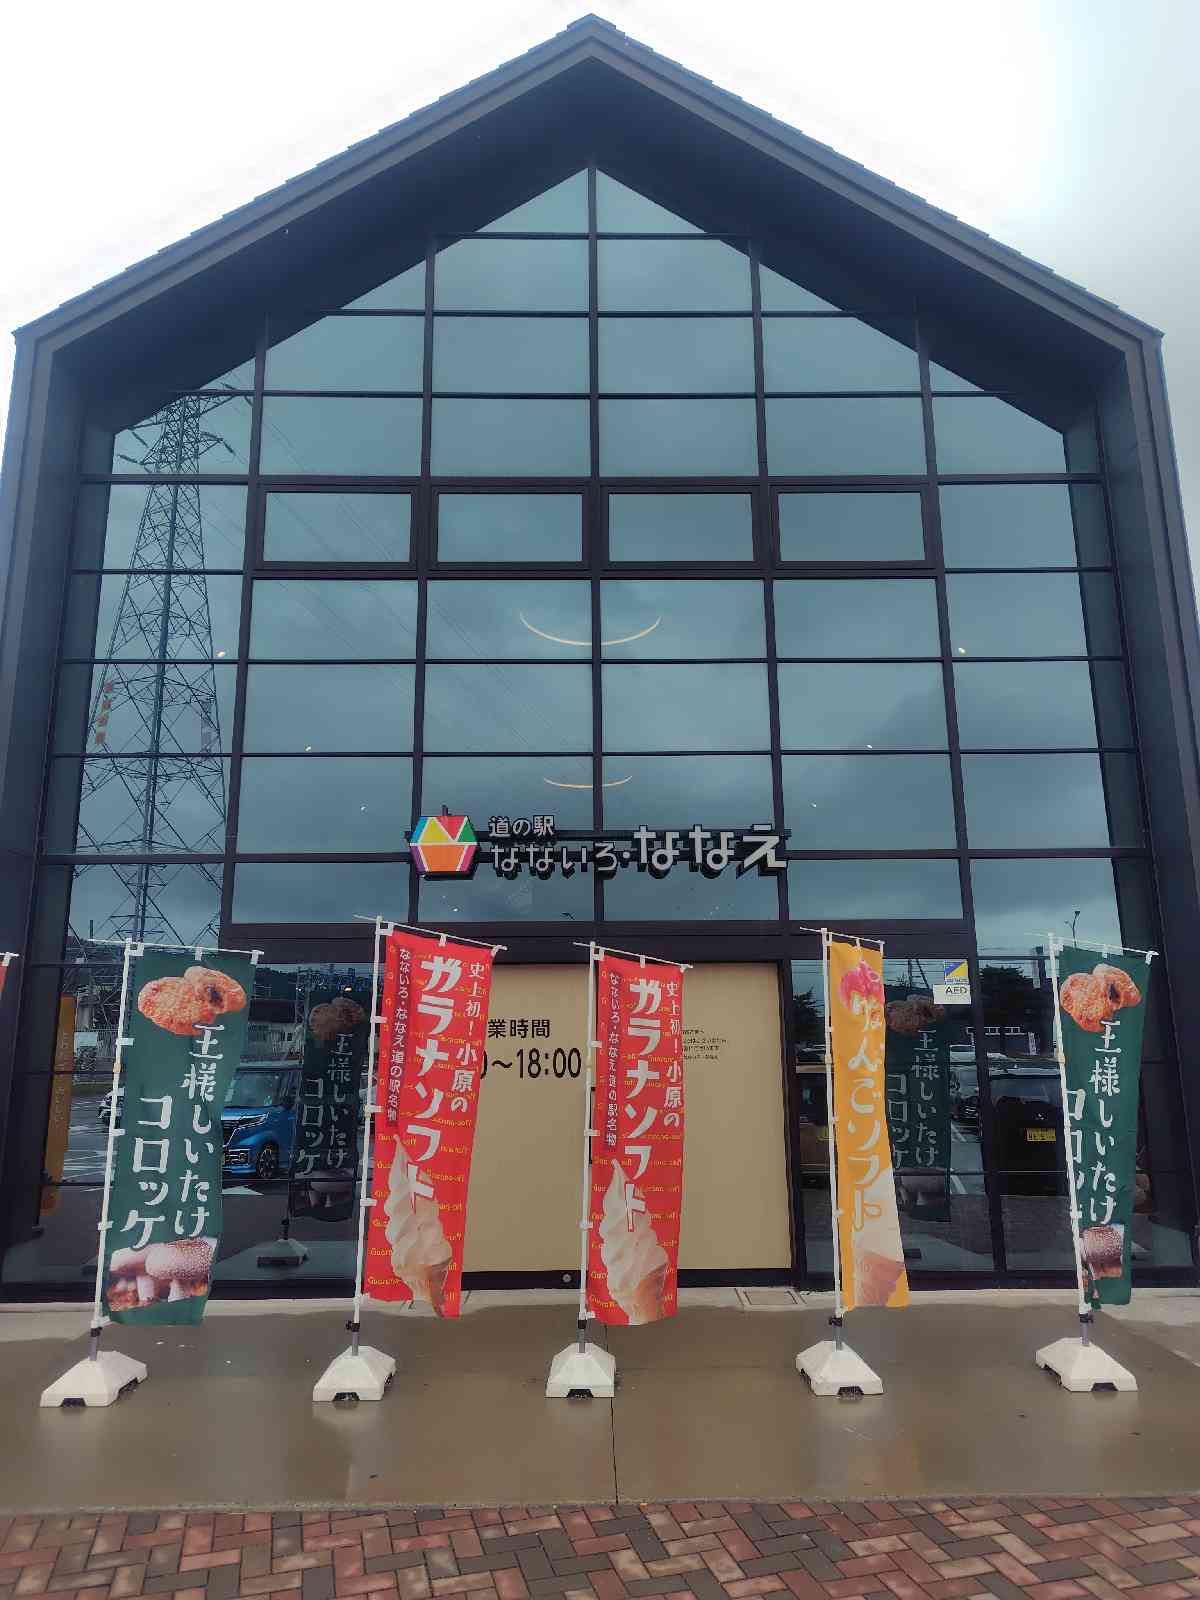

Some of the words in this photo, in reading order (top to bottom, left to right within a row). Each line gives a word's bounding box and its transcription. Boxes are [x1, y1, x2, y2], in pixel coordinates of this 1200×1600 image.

[489, 815, 554, 837] 道の駅
[490, 824, 787, 872] なないろ・ななえ
[945, 986, 968, 994] AED
[174, 1024, 225, 1238] 王様しいたけ
[296, 1077, 324, 1175] コロッケ
[406, 955, 462, 1215] ガラナソフト
[624, 978, 662, 1231] ガラナソフト
[911, 1029, 939, 1167] 王様しいたけ
[1090, 1020, 1122, 1225] 王様しいたけ
[120, 1095, 172, 1249] コロッケ
